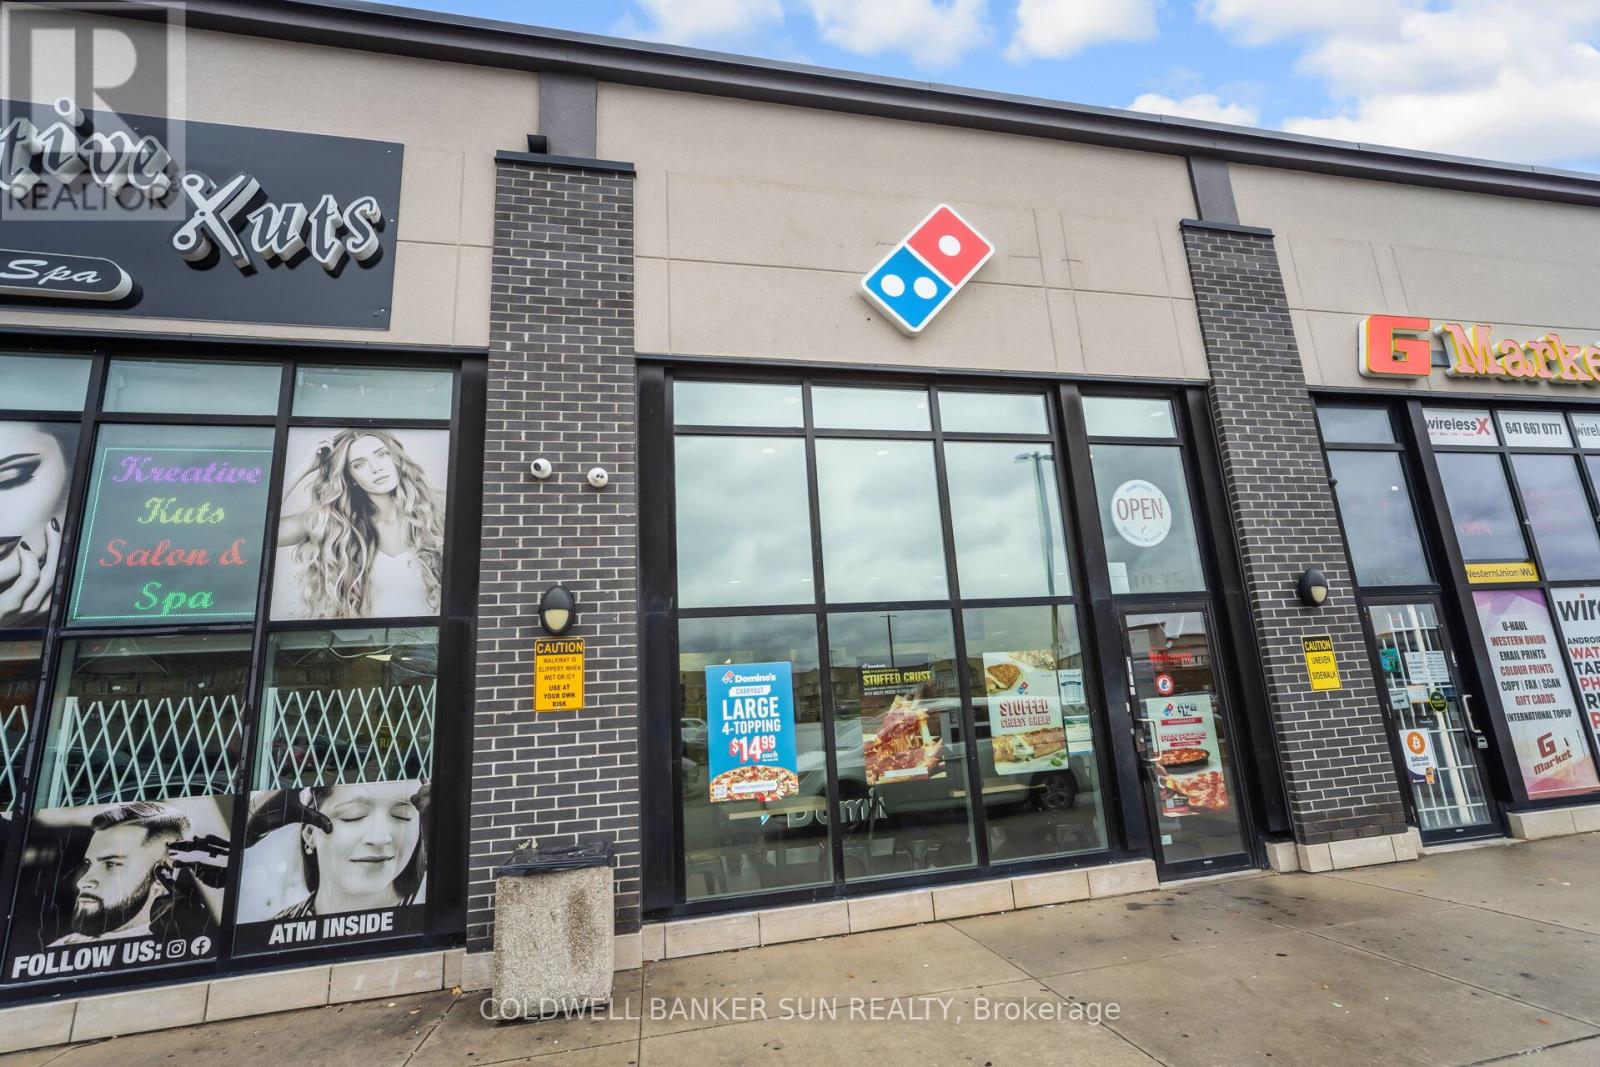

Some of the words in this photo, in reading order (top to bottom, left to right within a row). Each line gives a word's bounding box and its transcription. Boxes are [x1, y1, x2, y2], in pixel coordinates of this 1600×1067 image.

[0, 258, 103, 285] Spa
[1361, 314, 1431, 377] G
[1505, 421, 1522, 435] 647
[1524, 422, 1541, 435] 667
[1543, 422, 1562, 436] 0777
[112, 455, 264, 484] Kreative
[137, 496, 226, 525] Kuts
[1116, 497, 1164, 521] OPEN
[99, 538, 210, 567] Salon
[219, 539, 247, 566] &
[135, 581, 214, 616] Spa
[1501, 620, 1528, 632] U-HAUL
[537, 641, 583, 654] CAUTION
[1304, 640, 1331, 651] CAUTION
[1490, 635, 1524, 647] WESTERN
[1524, 634, 1546, 645] UNION
[1311, 655, 1331, 664] UNEVEN
[1499, 650, 1521, 661] EMAIL
[1521, 649, 1546, 660] PRINTS
[734, 672, 777, 683] Domino's
[863, 672, 902, 686] STUFFED
[903, 670, 932, 683] CRUST
[1312, 671, 1337, 679] SIDEWALK
[1500, 664, 1529, 677] COLOUR
[1529, 663, 1554, 675] PRINTS
[1500, 680, 1520, 692] COPY
[1524, 679, 1539, 691] FAX
[1542, 678, 1561, 689] SCAN
[999, 698, 1049, 717] STUFFED
[1515, 695, 1531, 706] GIFT
[1531, 693, 1556, 705] CARDS
[722, 696, 780, 721] LARGE
[1506, 710, 1553, 722] INTERNATIONAL
[1553, 708, 1572, 719] TOPUP
[722, 718, 781, 735] 4-TOPPING
[1537, 732, 1556, 758] G
[269, 919, 317, 946] ATM
[322, 911, 394, 940] INSIDE
[12, 943, 115, 979] FOLLOW
[122, 940, 162, 965] US:
